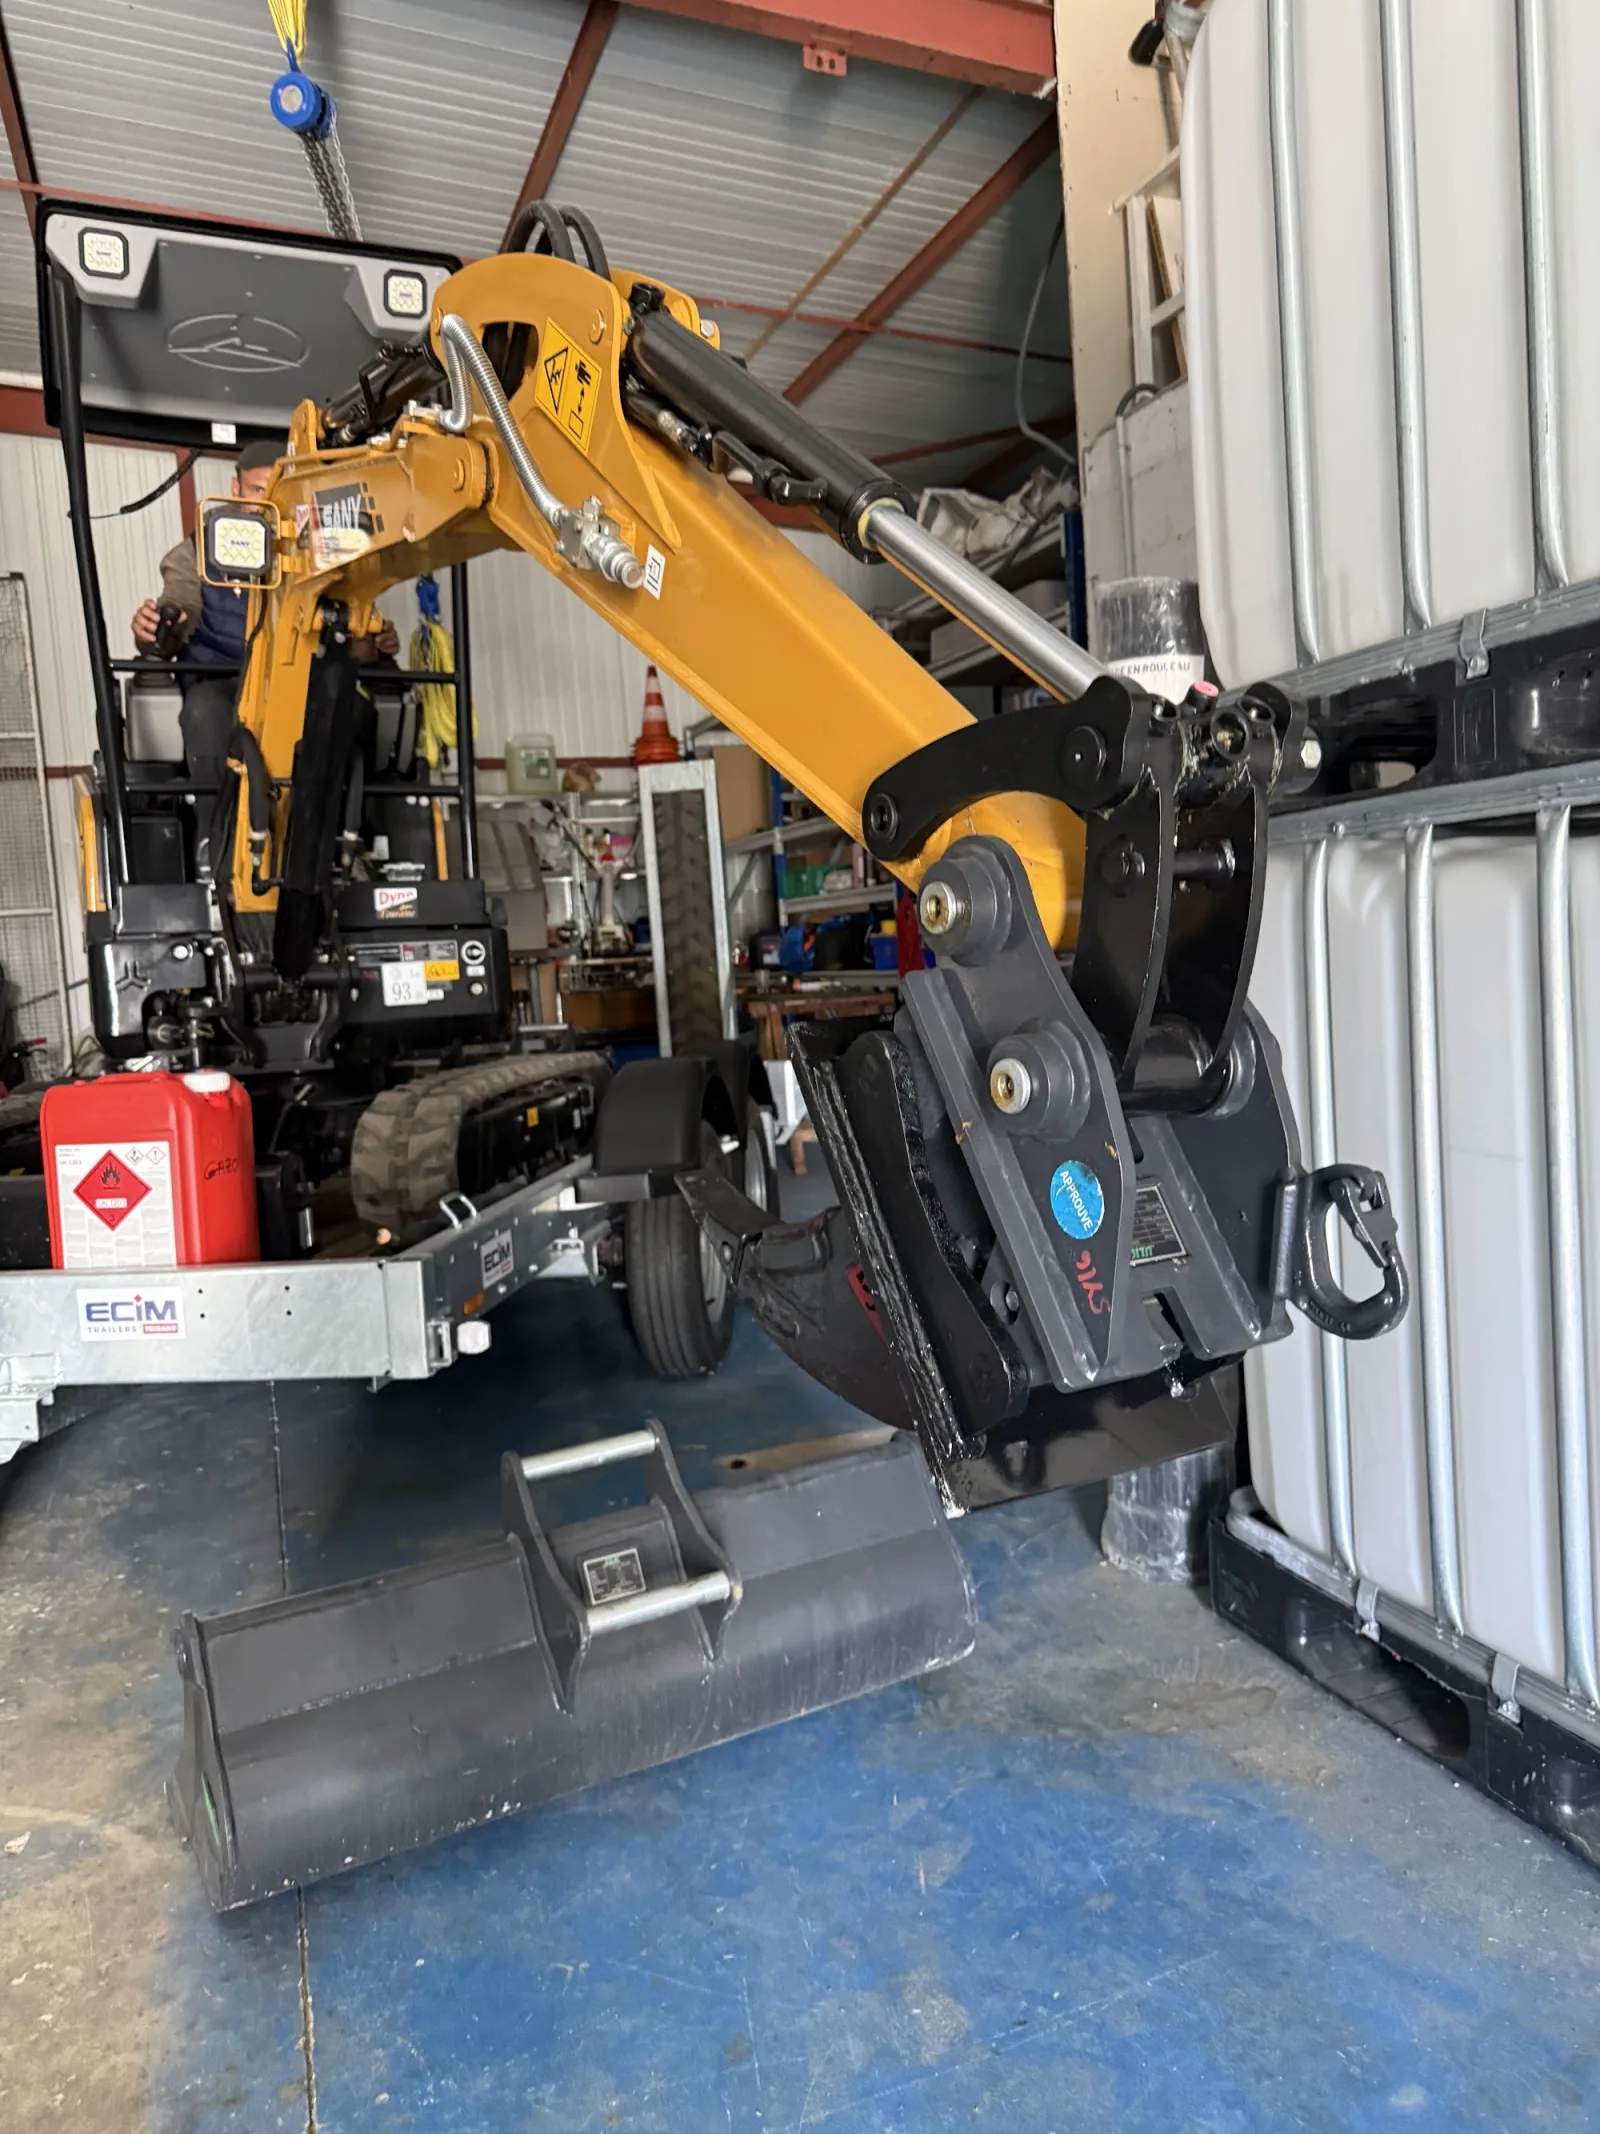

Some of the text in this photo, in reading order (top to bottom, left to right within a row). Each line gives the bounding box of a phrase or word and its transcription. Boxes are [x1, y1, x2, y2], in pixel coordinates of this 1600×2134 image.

[230, 539, 250, 547] SANY
[1142, 661, 1191, 675] ROULEAU
[392, 982, 412, 1002] 93
[1060, 1170, 1094, 1232] APPROUVE
[109, 1214, 115, 1222] 3
[87, 1325, 138, 1334] TRAILERS
